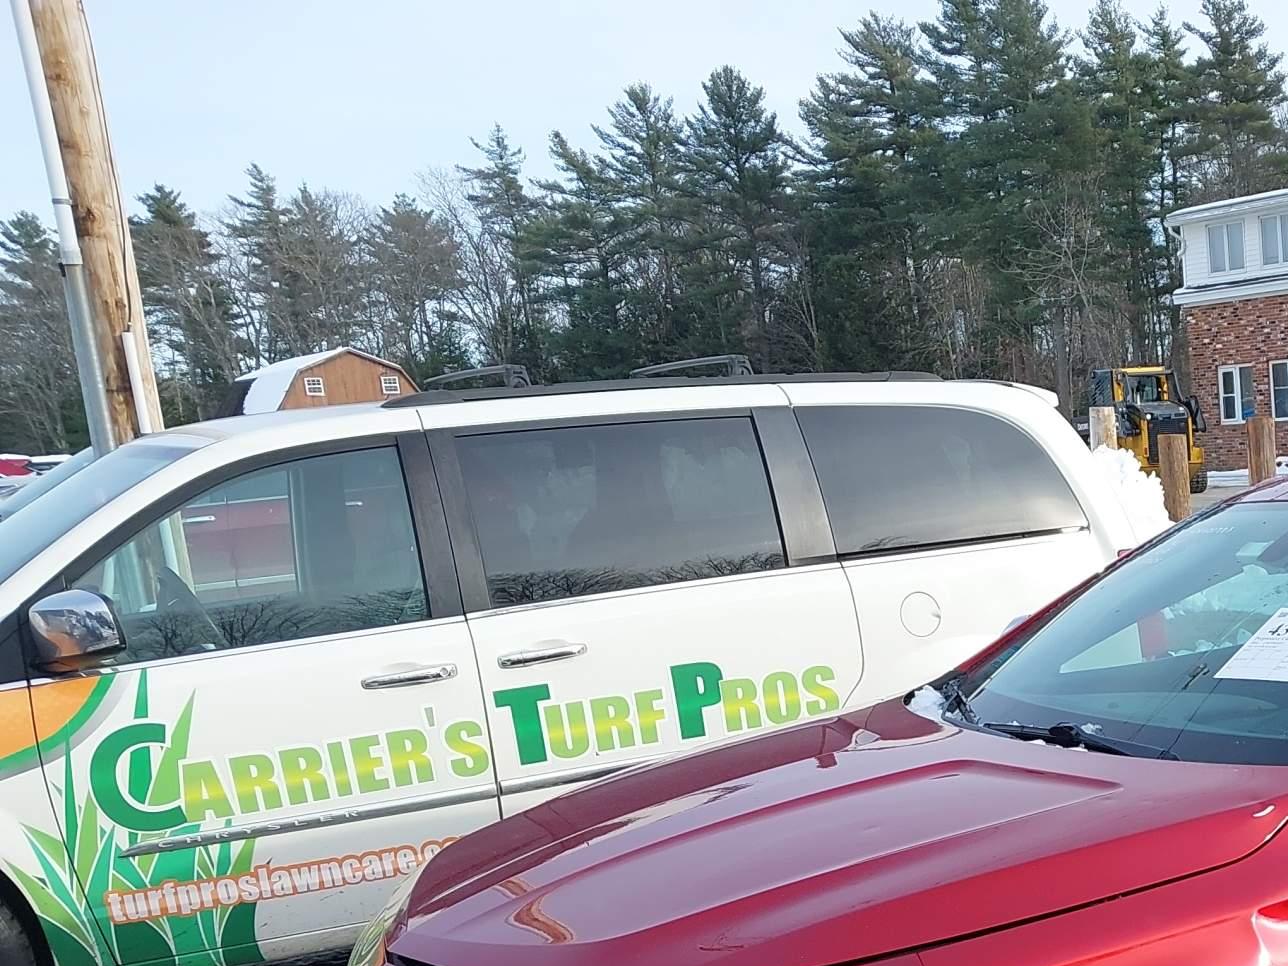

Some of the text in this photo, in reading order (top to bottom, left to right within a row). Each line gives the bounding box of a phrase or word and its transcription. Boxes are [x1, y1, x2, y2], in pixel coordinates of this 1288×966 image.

[89, 661, 840, 832] CARRIER'S TURF PROS
[158, 808, 360, 849] CHRYSLER
